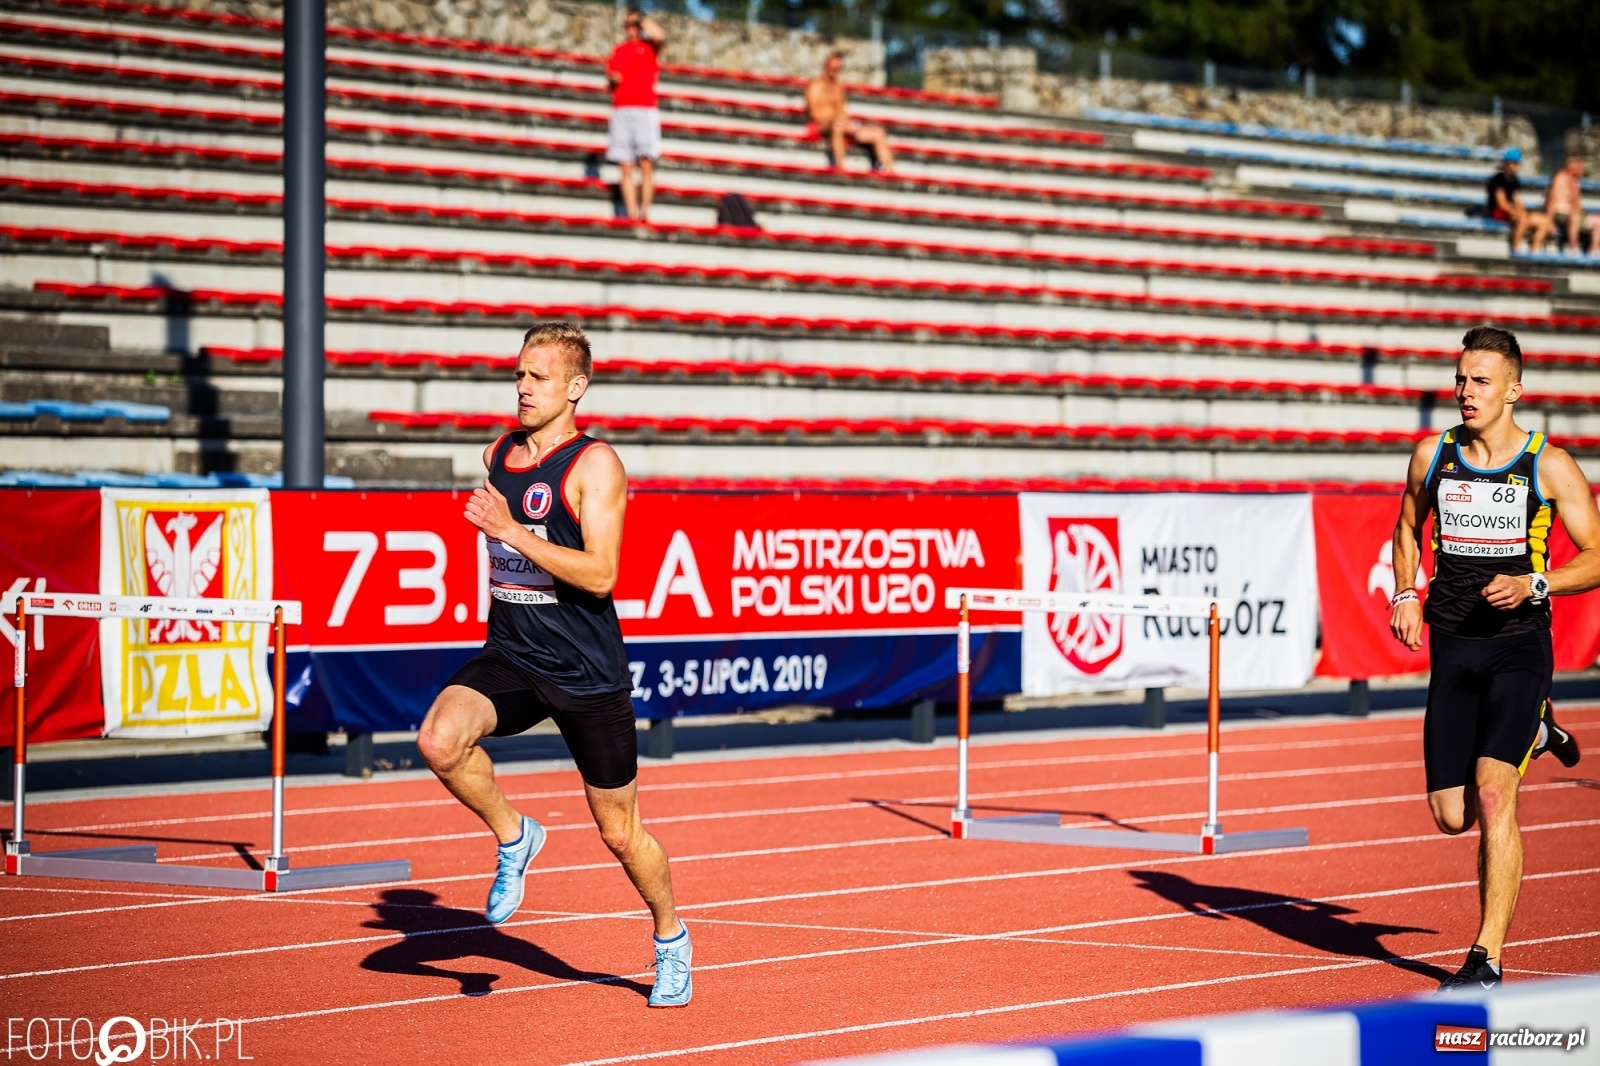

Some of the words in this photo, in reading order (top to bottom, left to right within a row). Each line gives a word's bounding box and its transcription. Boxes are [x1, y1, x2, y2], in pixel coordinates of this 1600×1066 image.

[1446, 493, 1471, 502] ORLEN
[1492, 487, 1516, 503] 68
[1444, 510, 1521, 529] ŻYGOWSKI
[732, 528, 985, 570] MISTRZOSTWA
[1141, 546, 1218, 575] MIASTO
[1449, 544, 1491, 555] RACIBÓRZ
[1493, 546, 1514, 555] 2019
[323, 531, 468, 627] 73.
[78, 602, 101, 610] ORLEN
[523, 593, 544, 602] 2019
[731, 574, 853, 617] POLSKI
[861, 573, 935, 614] U20
[132, 653, 250, 714] PZLA
[658, 659, 698, 697] 3-5
[701, 656, 769, 695] LIPCA
[773, 654, 828, 692] 2019
